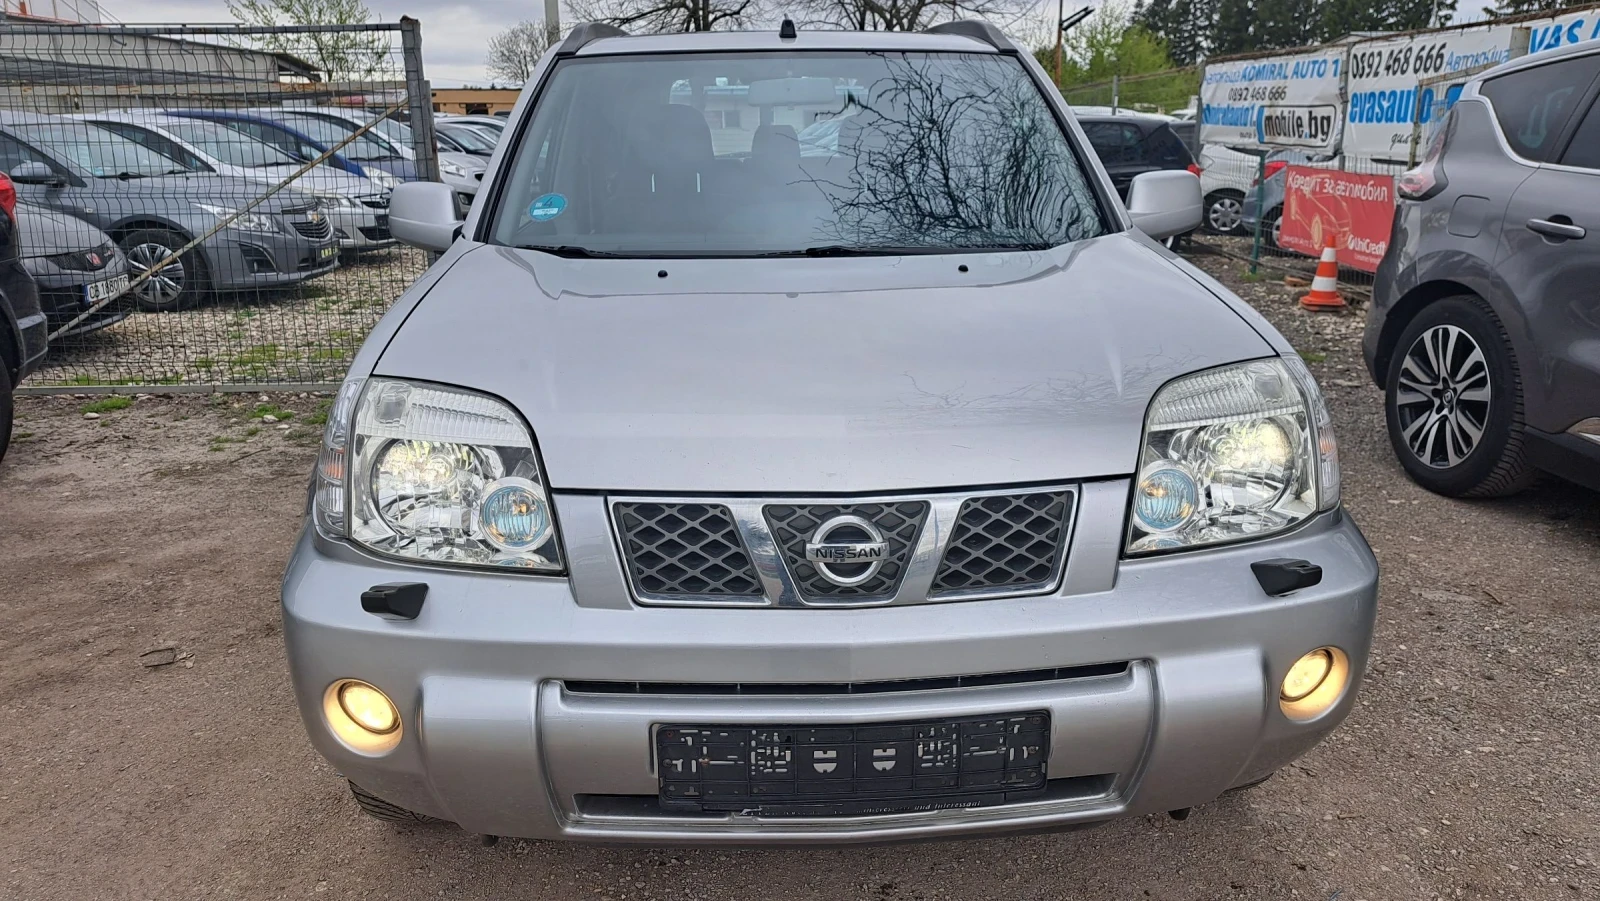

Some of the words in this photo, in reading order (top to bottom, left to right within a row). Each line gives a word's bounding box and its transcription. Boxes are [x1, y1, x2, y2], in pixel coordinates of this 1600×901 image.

[1240, 62, 1289, 83] ADMIRAL
[1290, 58, 1327, 80] AUTO
[1332, 58, 1340, 77] 1
[1351, 50, 1383, 79] 0892
[1385, 45, 1413, 76] 468
[1413, 41, 1447, 74] 666
[1227, 87, 1249, 103] 0892
[1250, 86, 1267, 102] 468
[1267, 85, 1288, 101] 666
[1265, 110, 1331, 143] mobile.bg
[544, 196, 553, 208] 4
[815, 547, 881, 559] NISSAN
